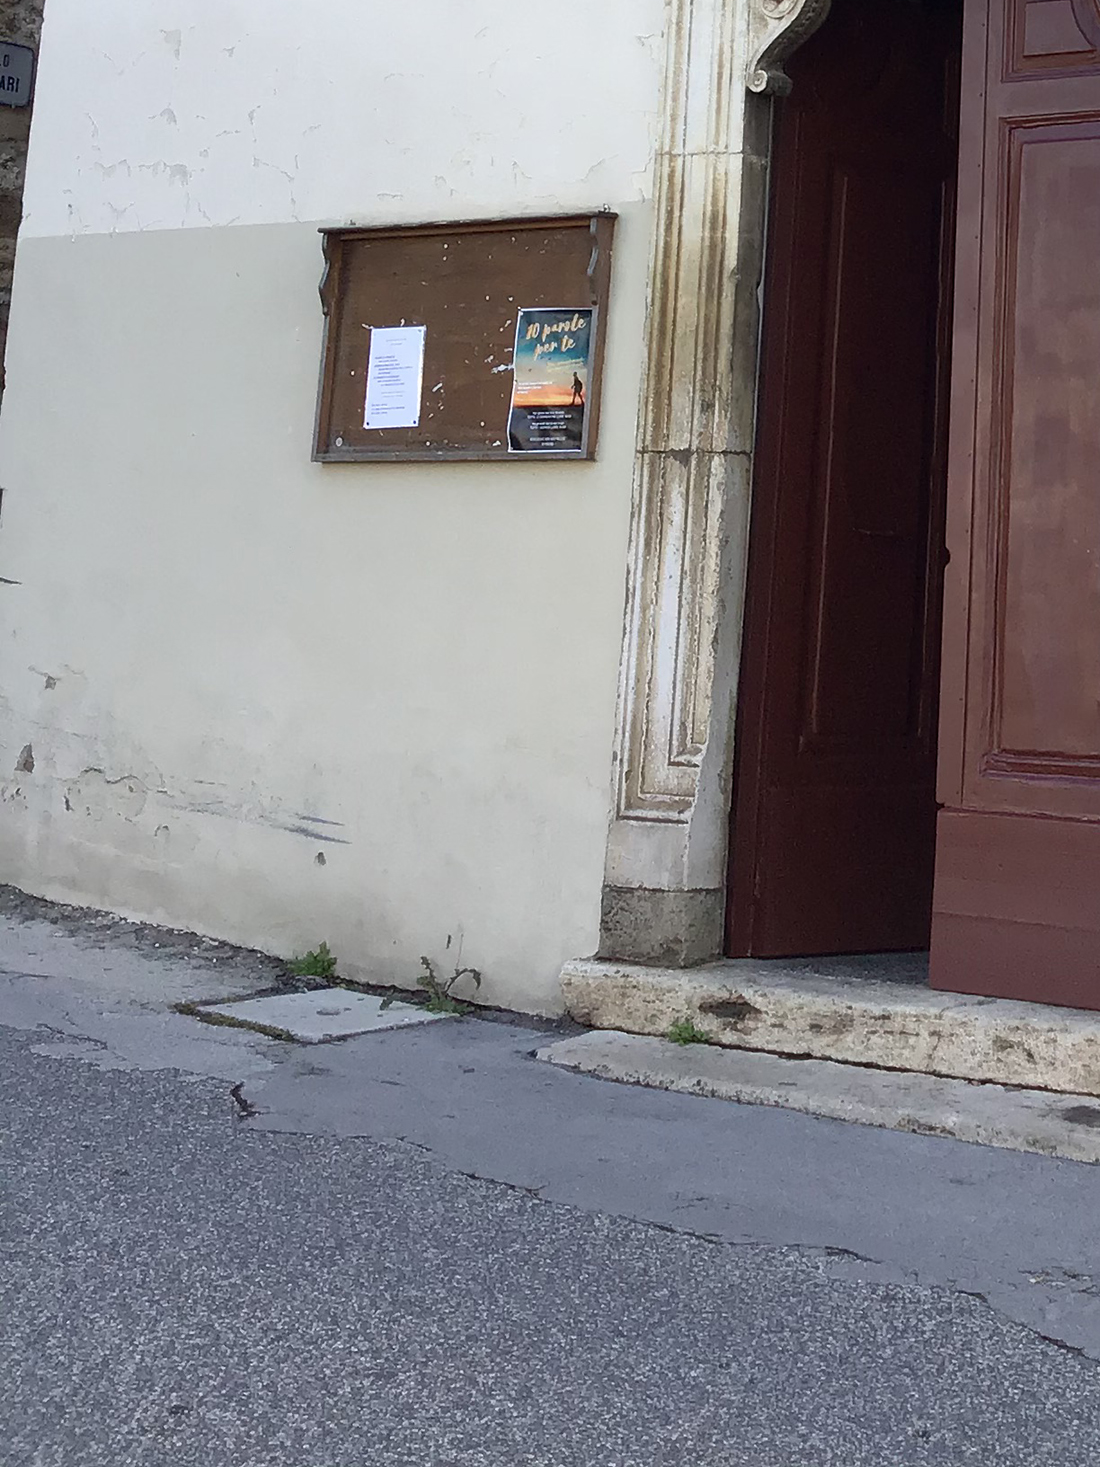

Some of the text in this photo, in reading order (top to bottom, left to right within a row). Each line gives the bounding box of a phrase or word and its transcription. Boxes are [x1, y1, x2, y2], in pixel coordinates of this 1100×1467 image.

[525, 313, 587, 342] 10 parole
[533, 335, 576, 361] per te
